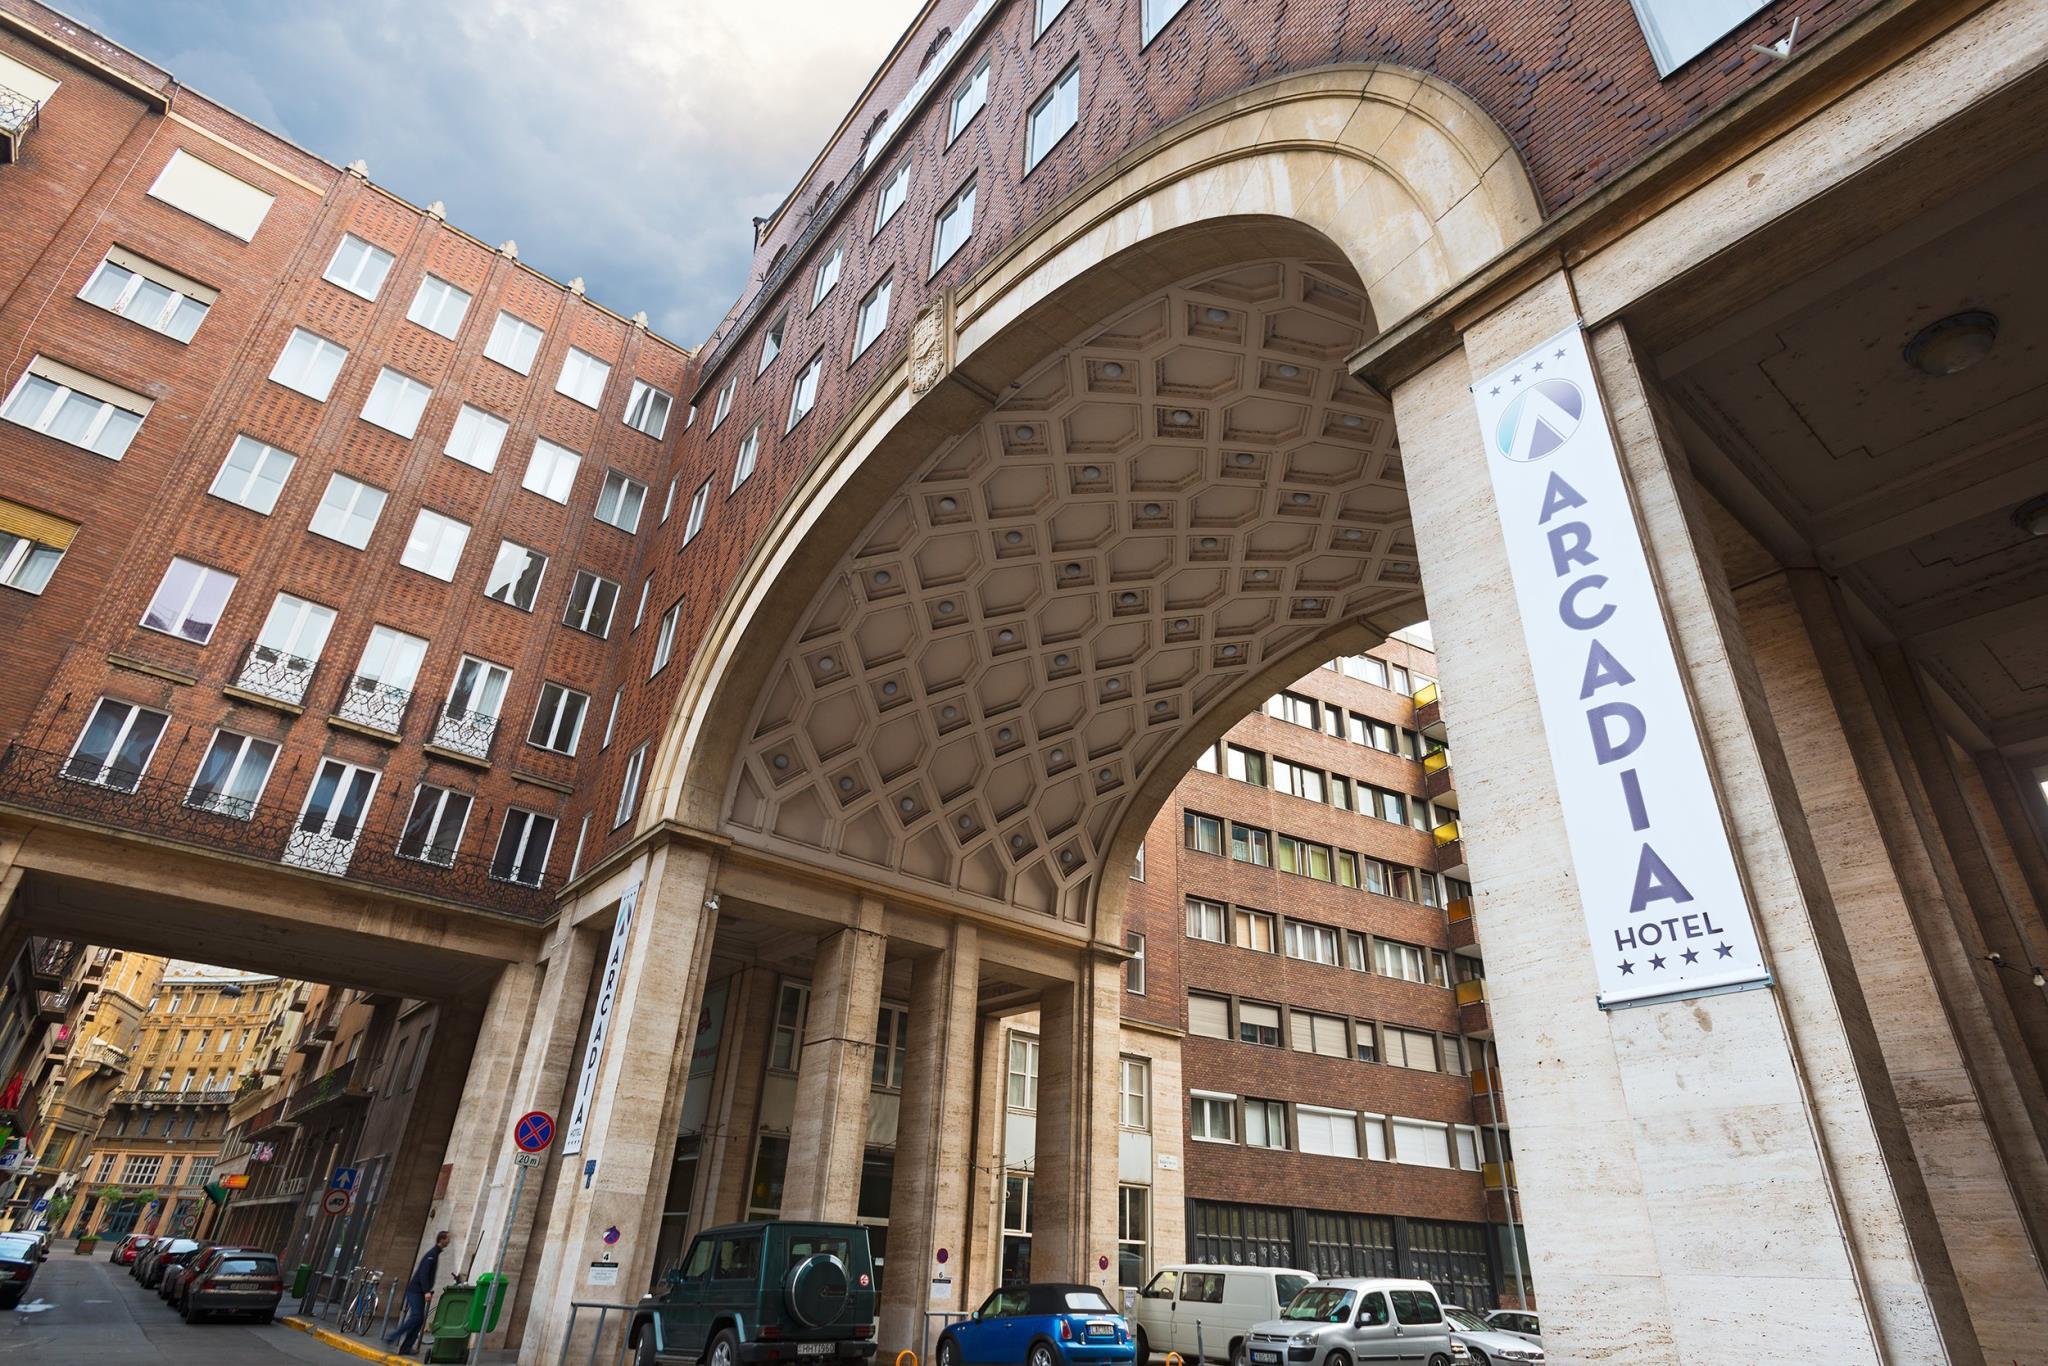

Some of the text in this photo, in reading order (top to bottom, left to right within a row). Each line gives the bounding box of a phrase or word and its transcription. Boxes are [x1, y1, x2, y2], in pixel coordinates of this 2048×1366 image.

[1538, 470, 1694, 913] ARCADIA
[1614, 912, 1724, 951] HOTEL
[574, 945, 620, 1125] ARCADIA
[518, 1154, 537, 1166] 20 m
